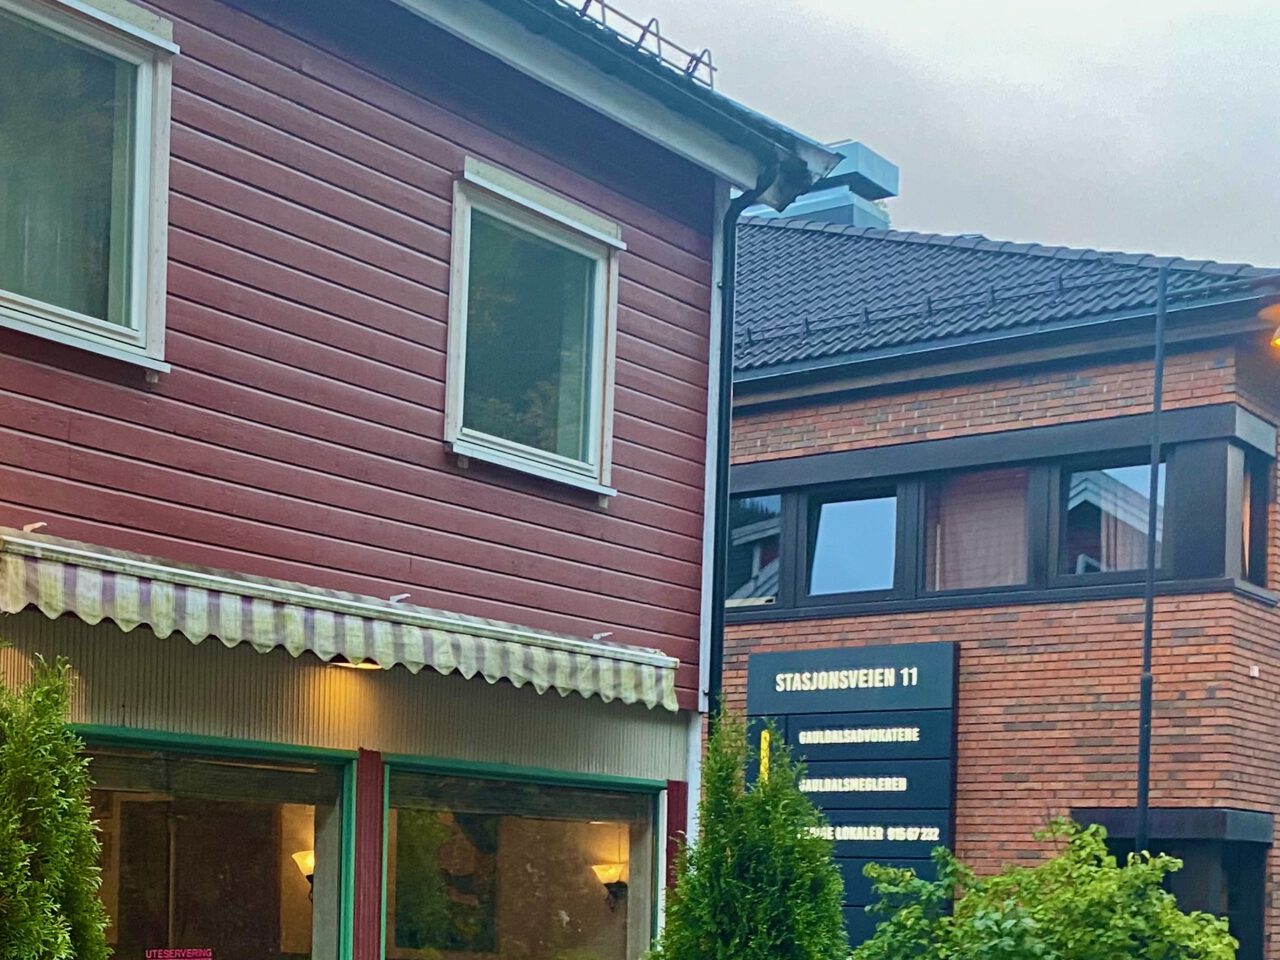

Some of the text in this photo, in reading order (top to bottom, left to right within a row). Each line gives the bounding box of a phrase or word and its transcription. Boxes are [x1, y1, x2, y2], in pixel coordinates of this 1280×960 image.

[775, 667, 918, 692] STASJONSVEIEN 11
[835, 826, 884, 841] LOKALER
[145, 948, 212, 958] UTESERVERING
